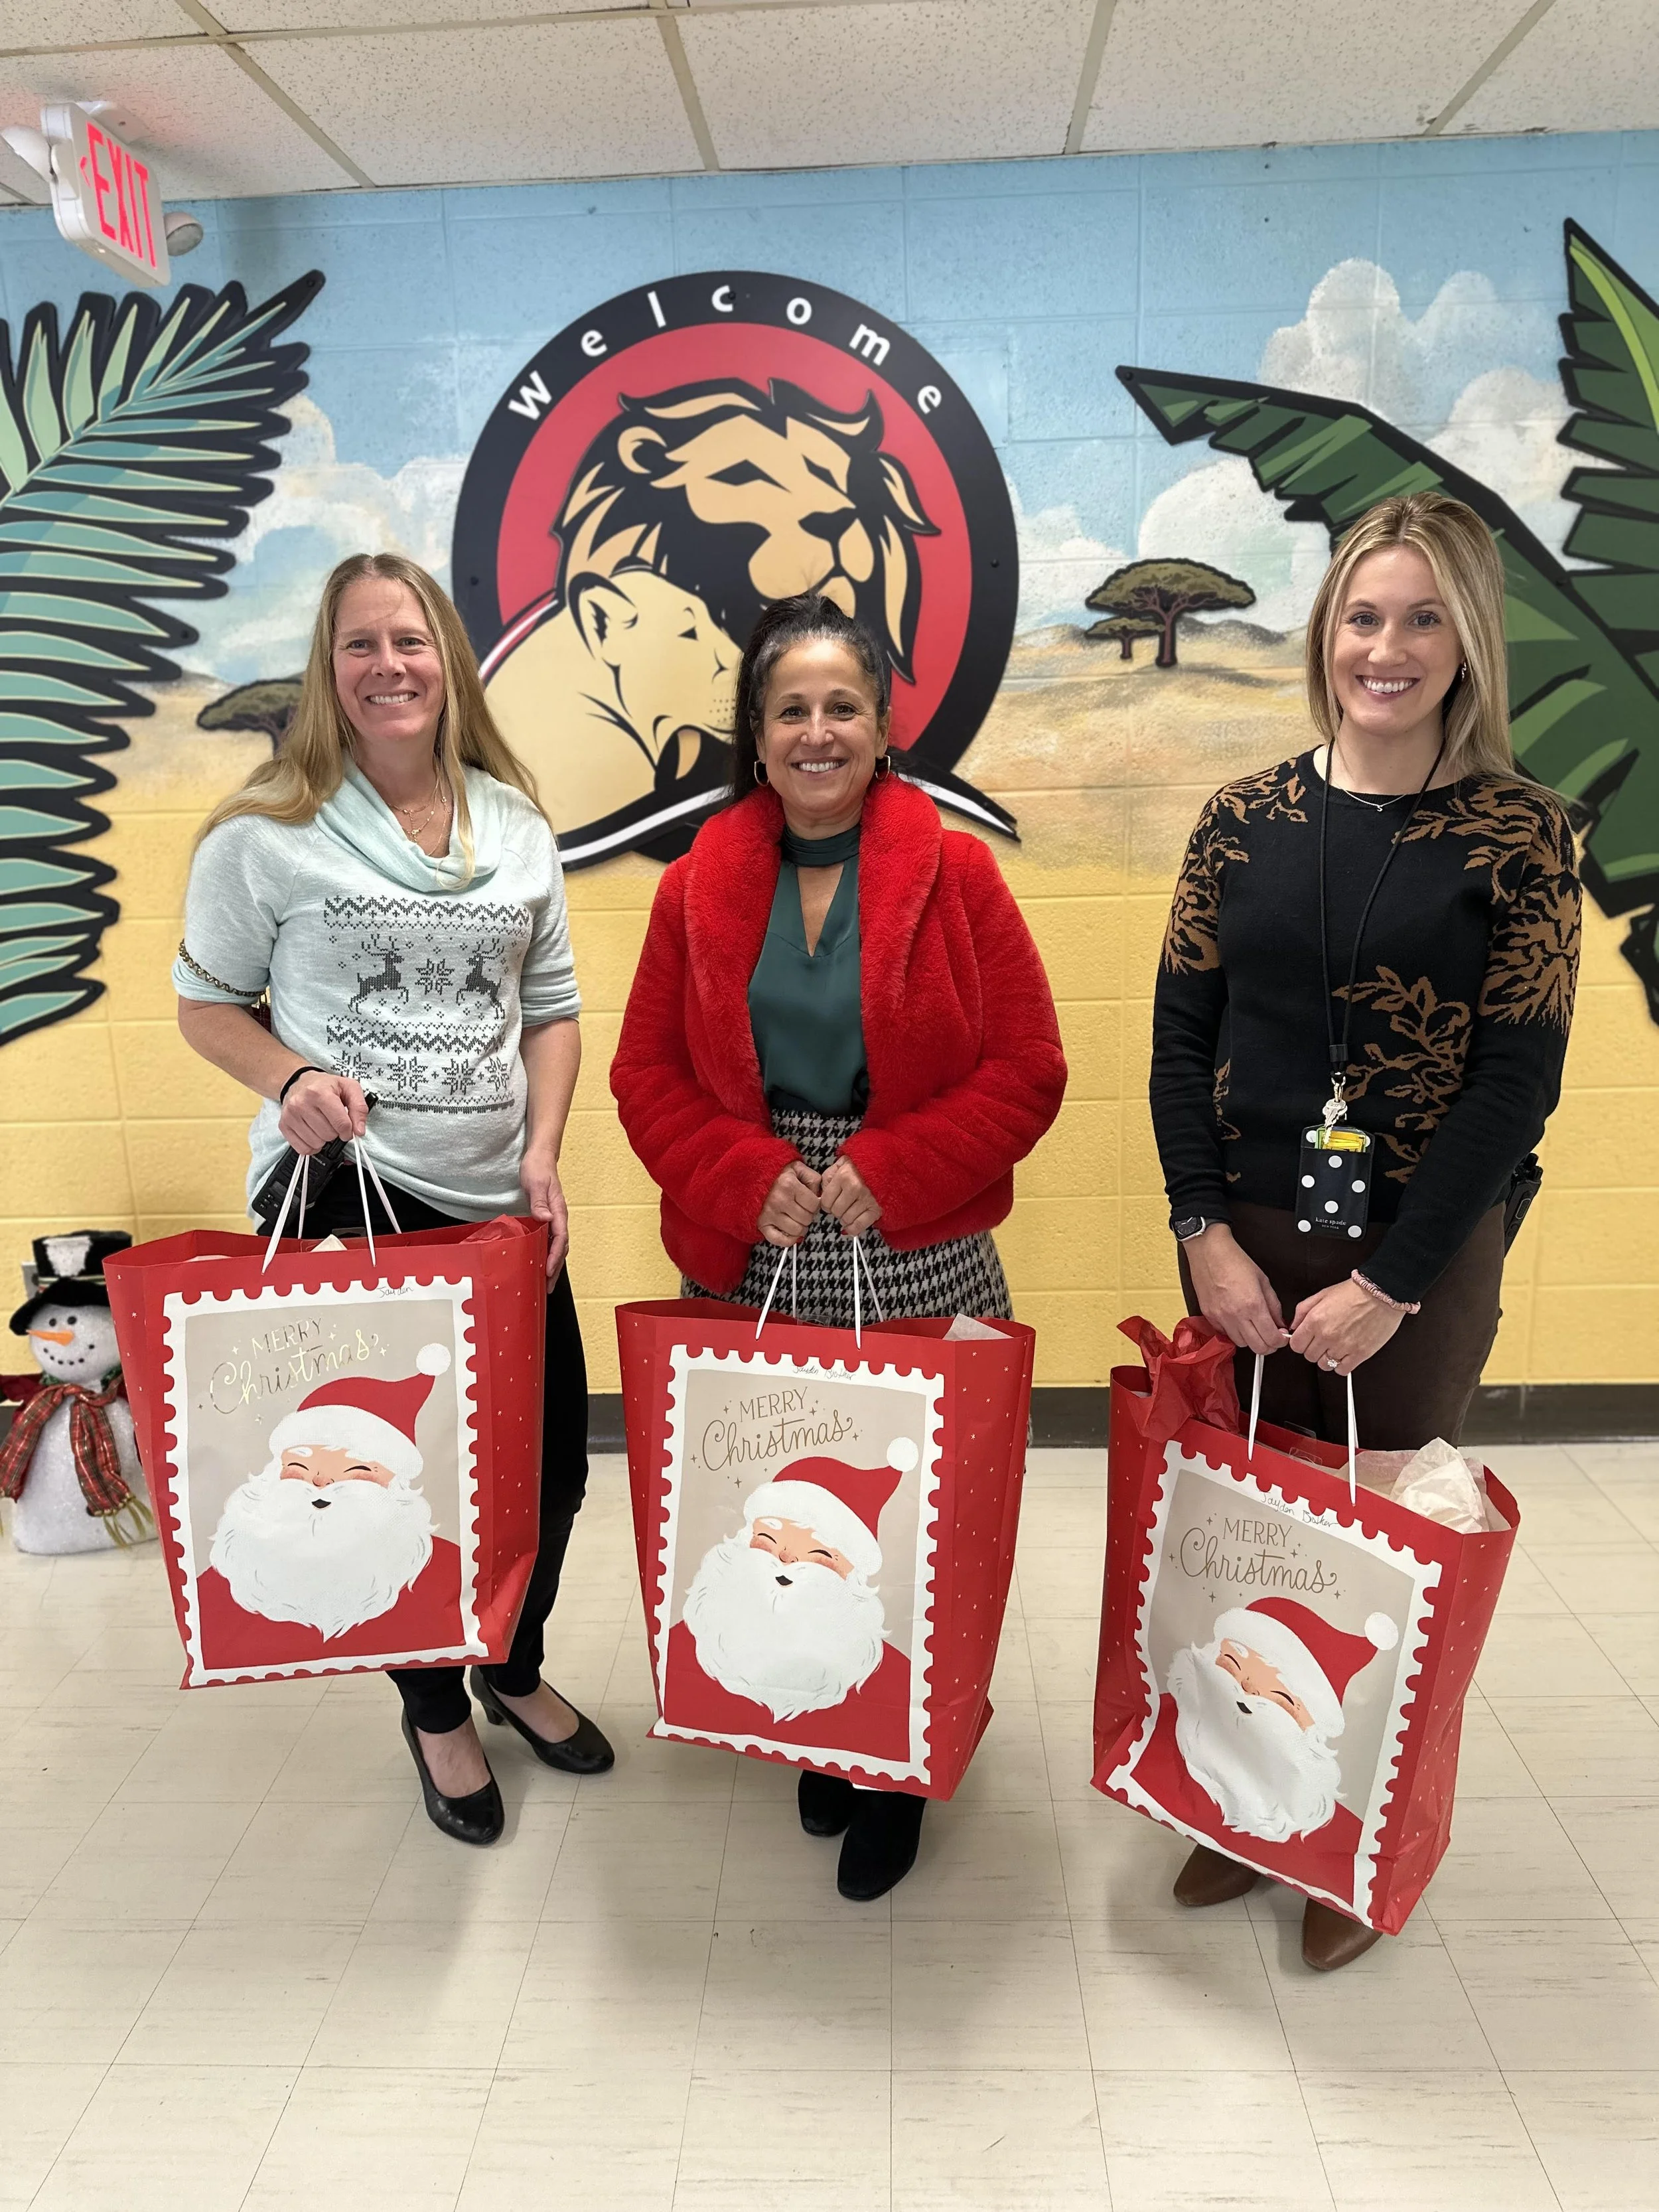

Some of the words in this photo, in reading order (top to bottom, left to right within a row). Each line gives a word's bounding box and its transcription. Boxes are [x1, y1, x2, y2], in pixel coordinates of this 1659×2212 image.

[87, 122, 157, 268] EXIT
[252, 1317, 322, 1358] MERRY
[210, 1329, 379, 1414] Christmas
[740, 1386, 808, 1422] MERRY
[702, 1409, 853, 1471] Christmas
[1181, 1528, 1337, 1593] Christmas
[1222, 1517, 1293, 1548] MERRY
